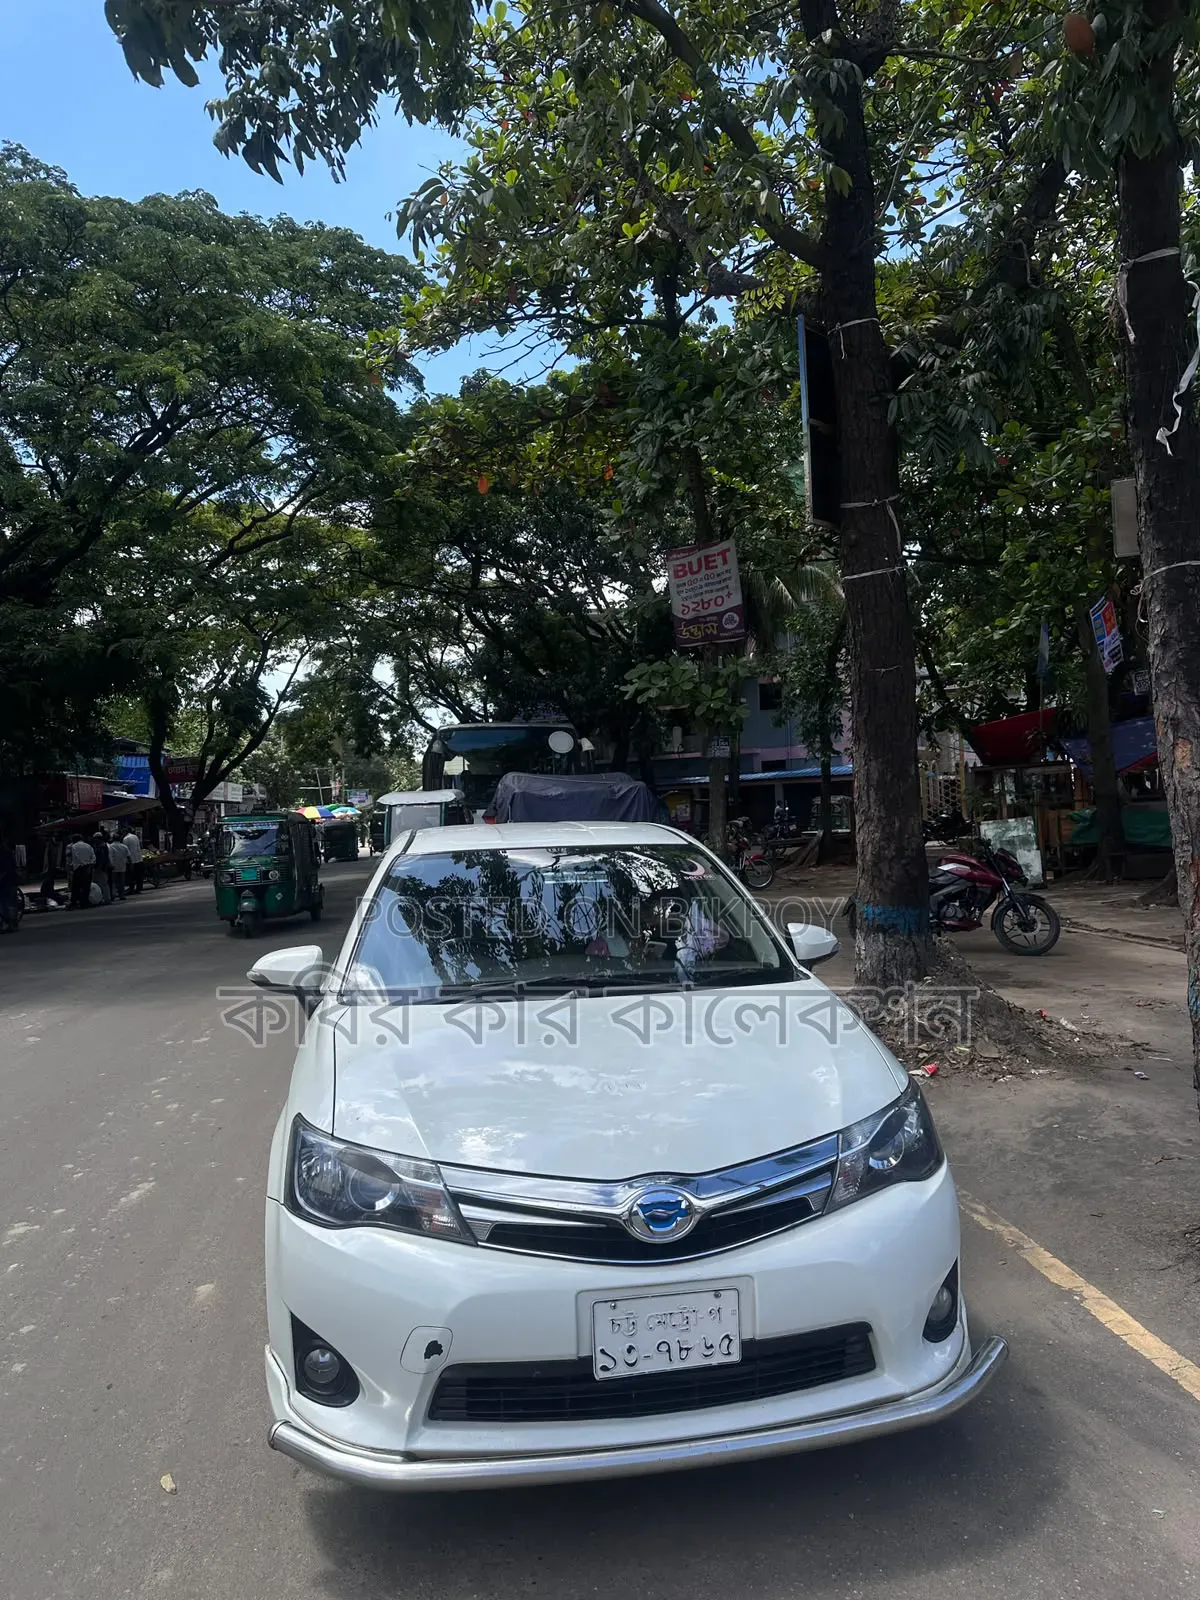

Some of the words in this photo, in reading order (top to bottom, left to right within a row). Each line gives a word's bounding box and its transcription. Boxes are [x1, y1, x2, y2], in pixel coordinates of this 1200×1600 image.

[673, 548, 732, 579] BUET
[680, 591, 733, 615] ১২৮০+
[608, 1309, 639, 1337] চট্ট
